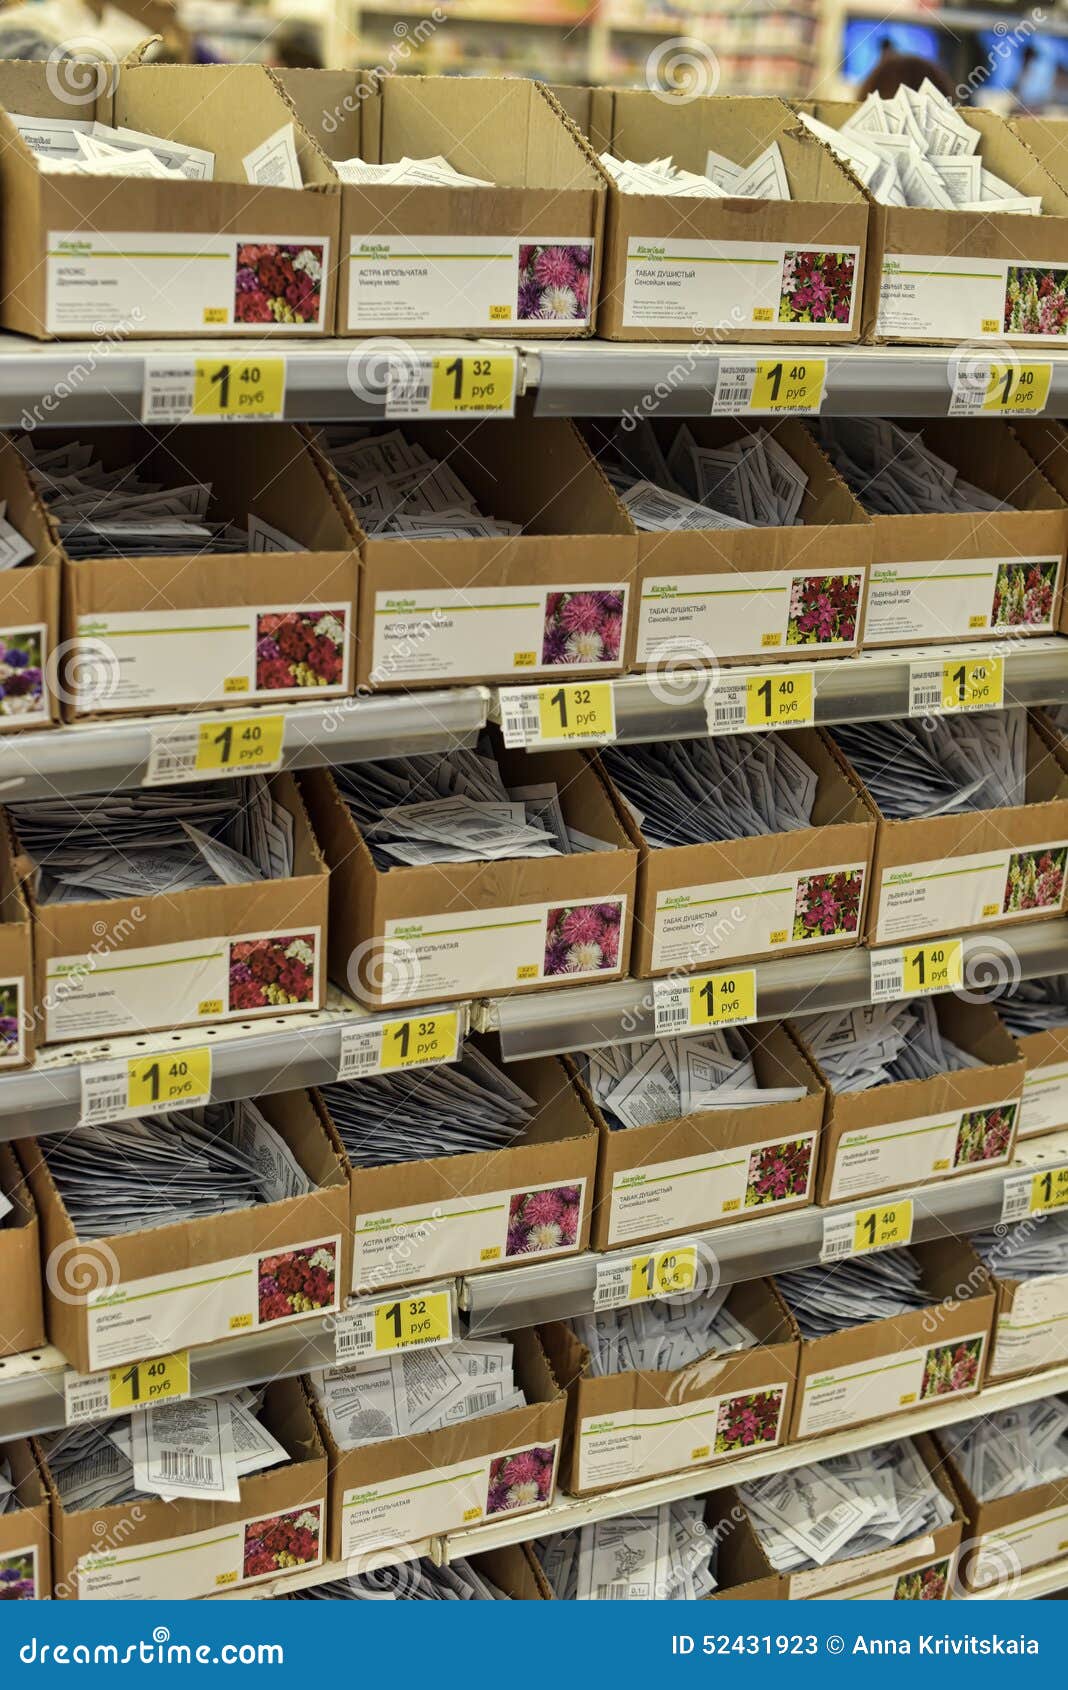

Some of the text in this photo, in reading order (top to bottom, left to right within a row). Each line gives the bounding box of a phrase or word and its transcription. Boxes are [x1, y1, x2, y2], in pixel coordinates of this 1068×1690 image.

[359, 269, 381, 277] АСТРА
[657, 270, 696, 278] ДУШИСТЫЙ
[211, 365, 260, 408] 1 40
[446, 358, 491, 400] 1 32
[766, 363, 806, 401] 1 40
[999, 369, 1033, 404] 1 40
[238, 389, 264, 405] руб
[472, 384, 494, 397] руб
[786, 386, 807, 398] руб
[1015, 391, 1033, 402] руб
[670, 605, 706, 614] ДУШИСТЫЙ
[953, 665, 986, 701] 1 40
[758, 680, 793, 717] 1 40
[972, 686, 989, 699] руб
[551, 689, 591, 728] 1 32
[779, 700, 798, 714] руб
[576, 712, 597, 725] руб
[214, 726, 232, 763] 1
[241, 726, 261, 741] 40
[239, 746, 263, 760] руб
[912, 951, 925, 985] 1
[931, 950, 944, 963] 40
[931, 967, 948, 981] руб
[700, 980, 714, 1017] 1
[720, 981, 736, 994] 40
[721, 999, 740, 1014] руб
[393, 1022, 410, 1058] 1
[418, 1022, 435, 1036] 32
[416, 1039, 438, 1054] руб
[142, 1063, 160, 1101] 1
[169, 1062, 188, 1077] 40
[169, 1081, 192, 1097] руб
[1040, 1171, 1068, 1202] 1 40
[864, 1213, 877, 1244] 1
[882, 1212, 896, 1224] 40
[881, 1227, 898, 1239] руб
[641, 1258, 655, 1290] 1
[661, 1256, 676, 1269] 40
[660, 1273, 679, 1286] руб
[386, 1303, 402, 1338] 1
[410, 1301, 426, 1315] 32
[410, 1319, 431, 1334] руб
[122, 1365, 140, 1400] 1
[147, 1362, 165, 1377] 40
[149, 1380, 171, 1395] руб
